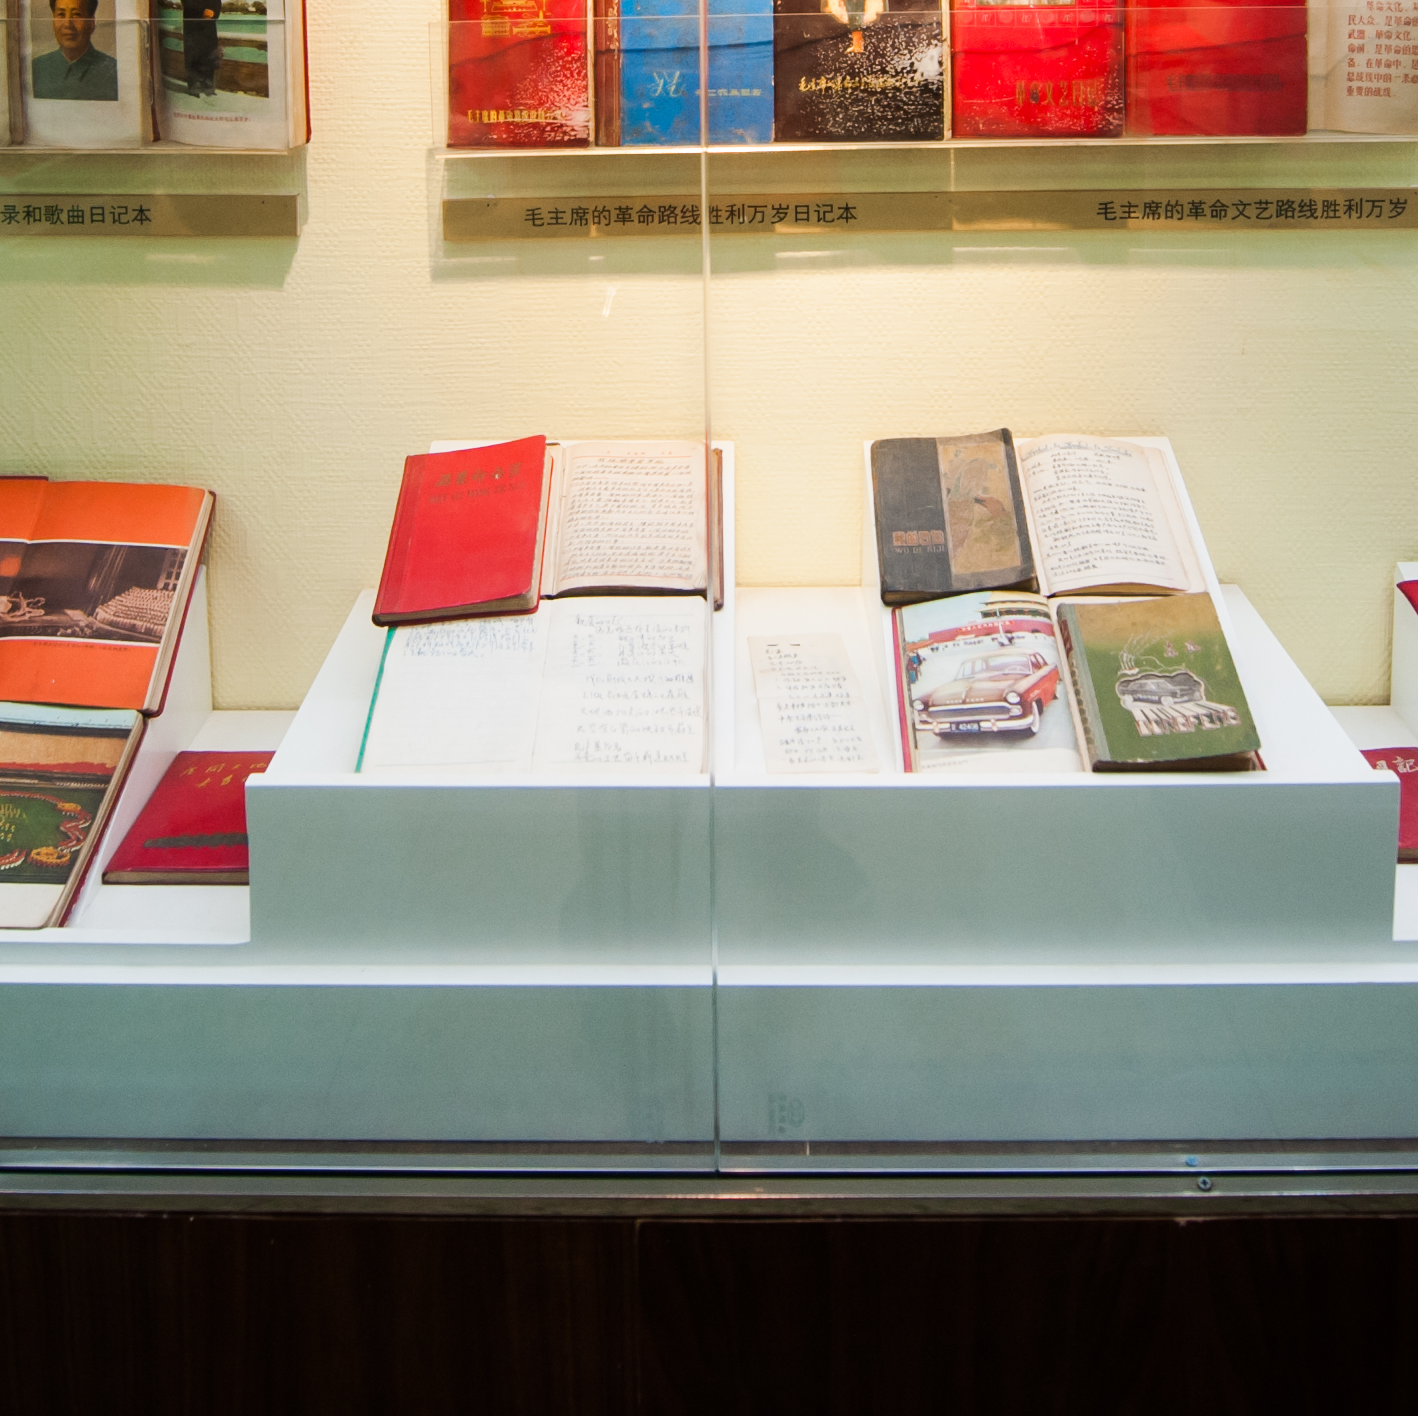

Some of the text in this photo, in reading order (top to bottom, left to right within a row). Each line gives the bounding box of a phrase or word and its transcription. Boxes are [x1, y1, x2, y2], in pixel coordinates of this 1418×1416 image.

[524, 202, 858, 228] 毛主席的革命路线胜利万岁日记本
[1096, 197, 1408, 223] 毛主席的革命文艺路线胜利万岁
